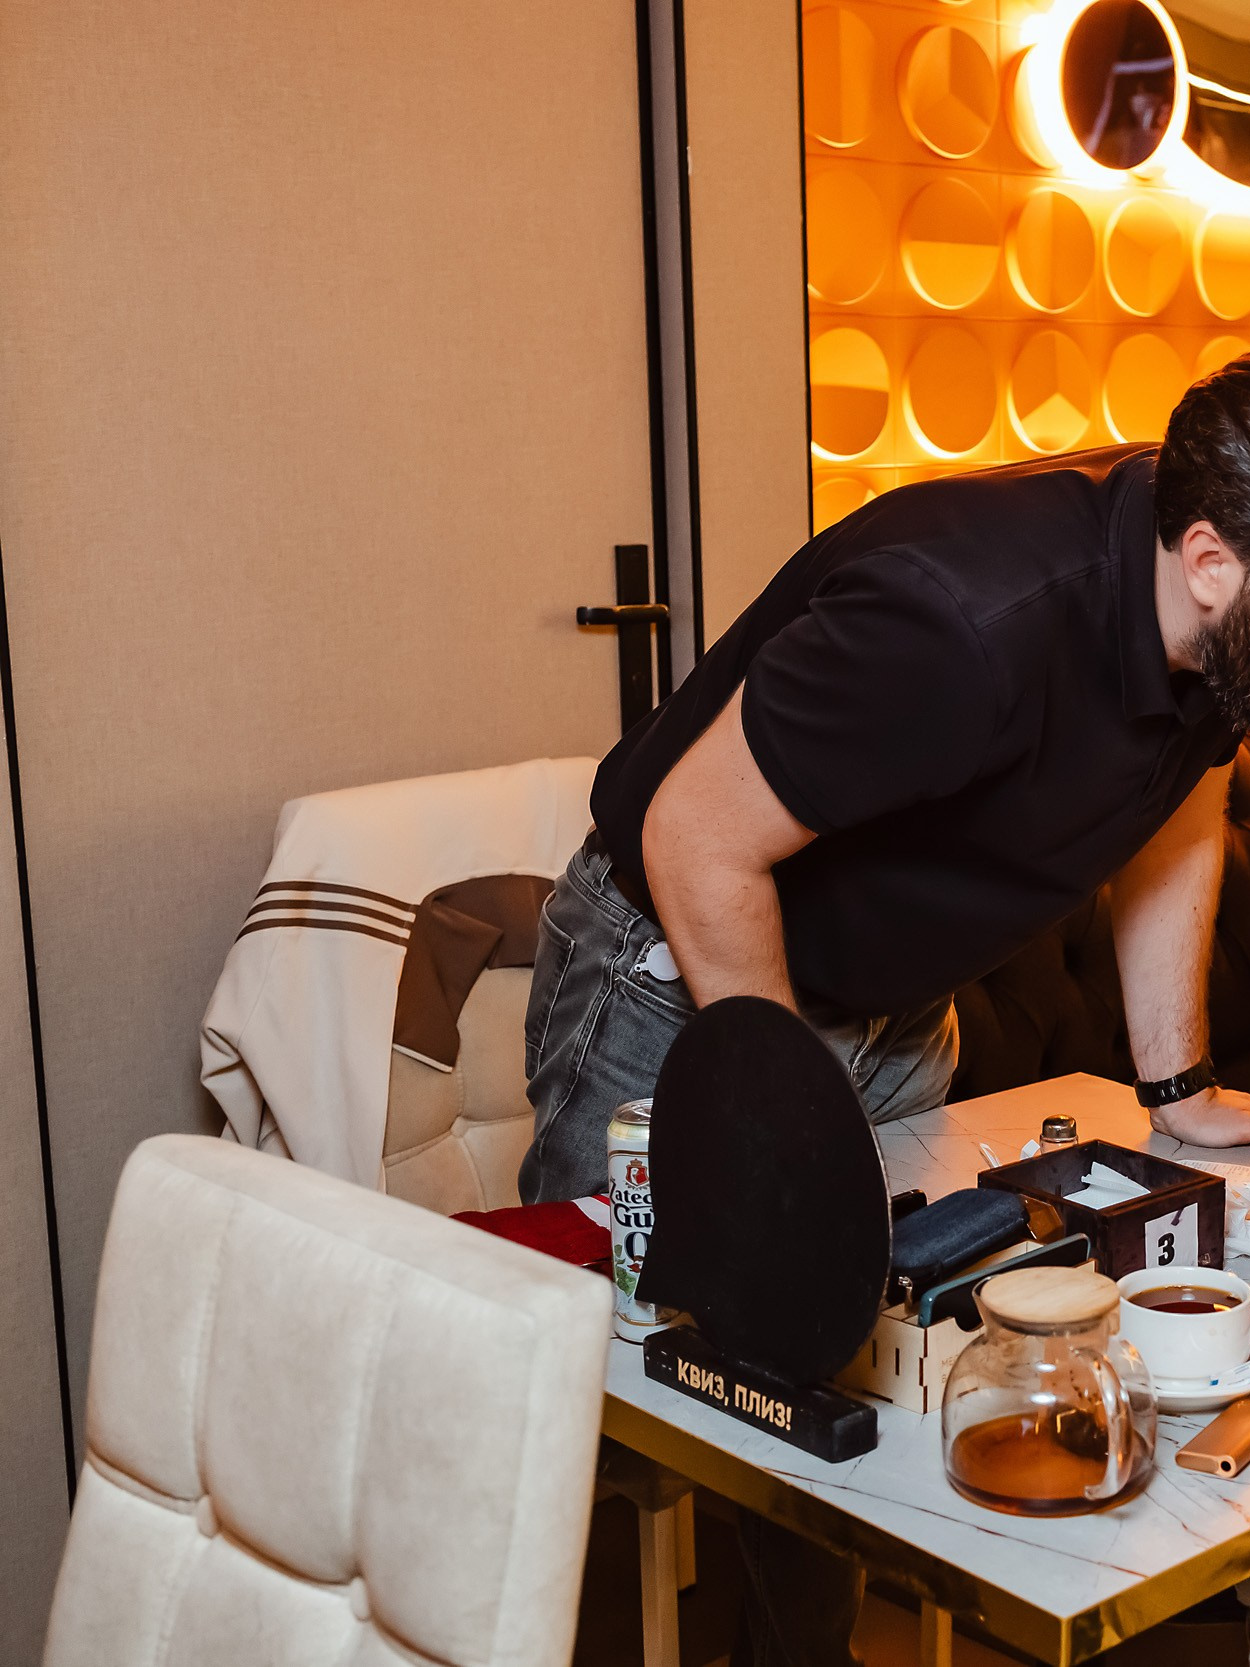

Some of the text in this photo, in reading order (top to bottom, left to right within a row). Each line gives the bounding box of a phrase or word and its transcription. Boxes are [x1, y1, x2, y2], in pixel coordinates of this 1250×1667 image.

[614, 1203, 654, 1228] Gu
[1157, 1232, 1175, 1267] 3
[677, 1356, 792, 1431] КВИЗ, ПЛИЗ!
